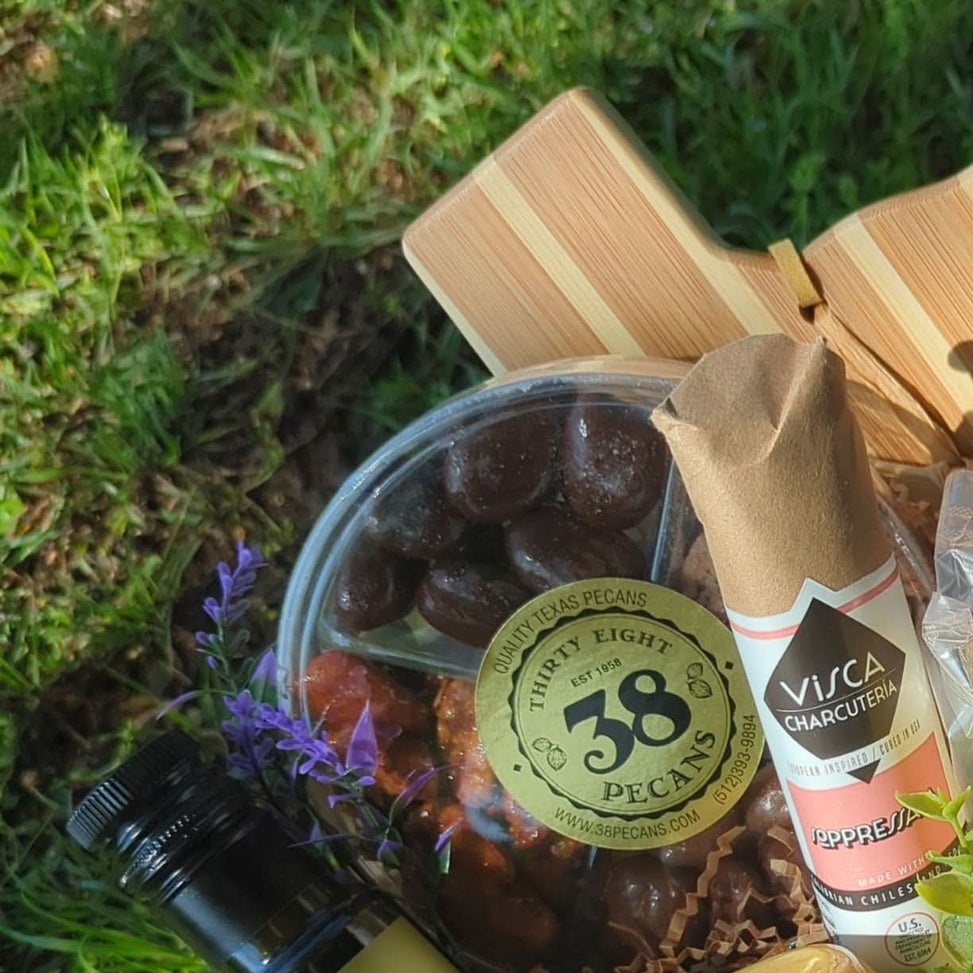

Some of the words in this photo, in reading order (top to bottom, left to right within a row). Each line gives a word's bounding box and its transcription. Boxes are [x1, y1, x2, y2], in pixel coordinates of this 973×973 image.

[493, 622, 534, 675] QUALITY
[534, 594, 579, 625] TEXAS
[583, 588, 648, 609] PECANS
[529, 635, 582, 712] THIRTY
[594, 627, 673, 656] EIGHT
[570, 669, 594, 688] EST
[595, 657, 623, 679] 1958
[563, 668, 692, 775] 38
[602, 729, 717, 804] PECANS
[825, 752, 868, 774] INSPIRED
[879, 733, 902, 756] CURED
[554, 806, 702, 841] WWW.38PECANS.COM
[858, 870, 893, 887] MADE
[898, 856, 926, 875] WITH
[861, 882, 914, 906] CHILES
[898, 917, 922, 933] U.S.
